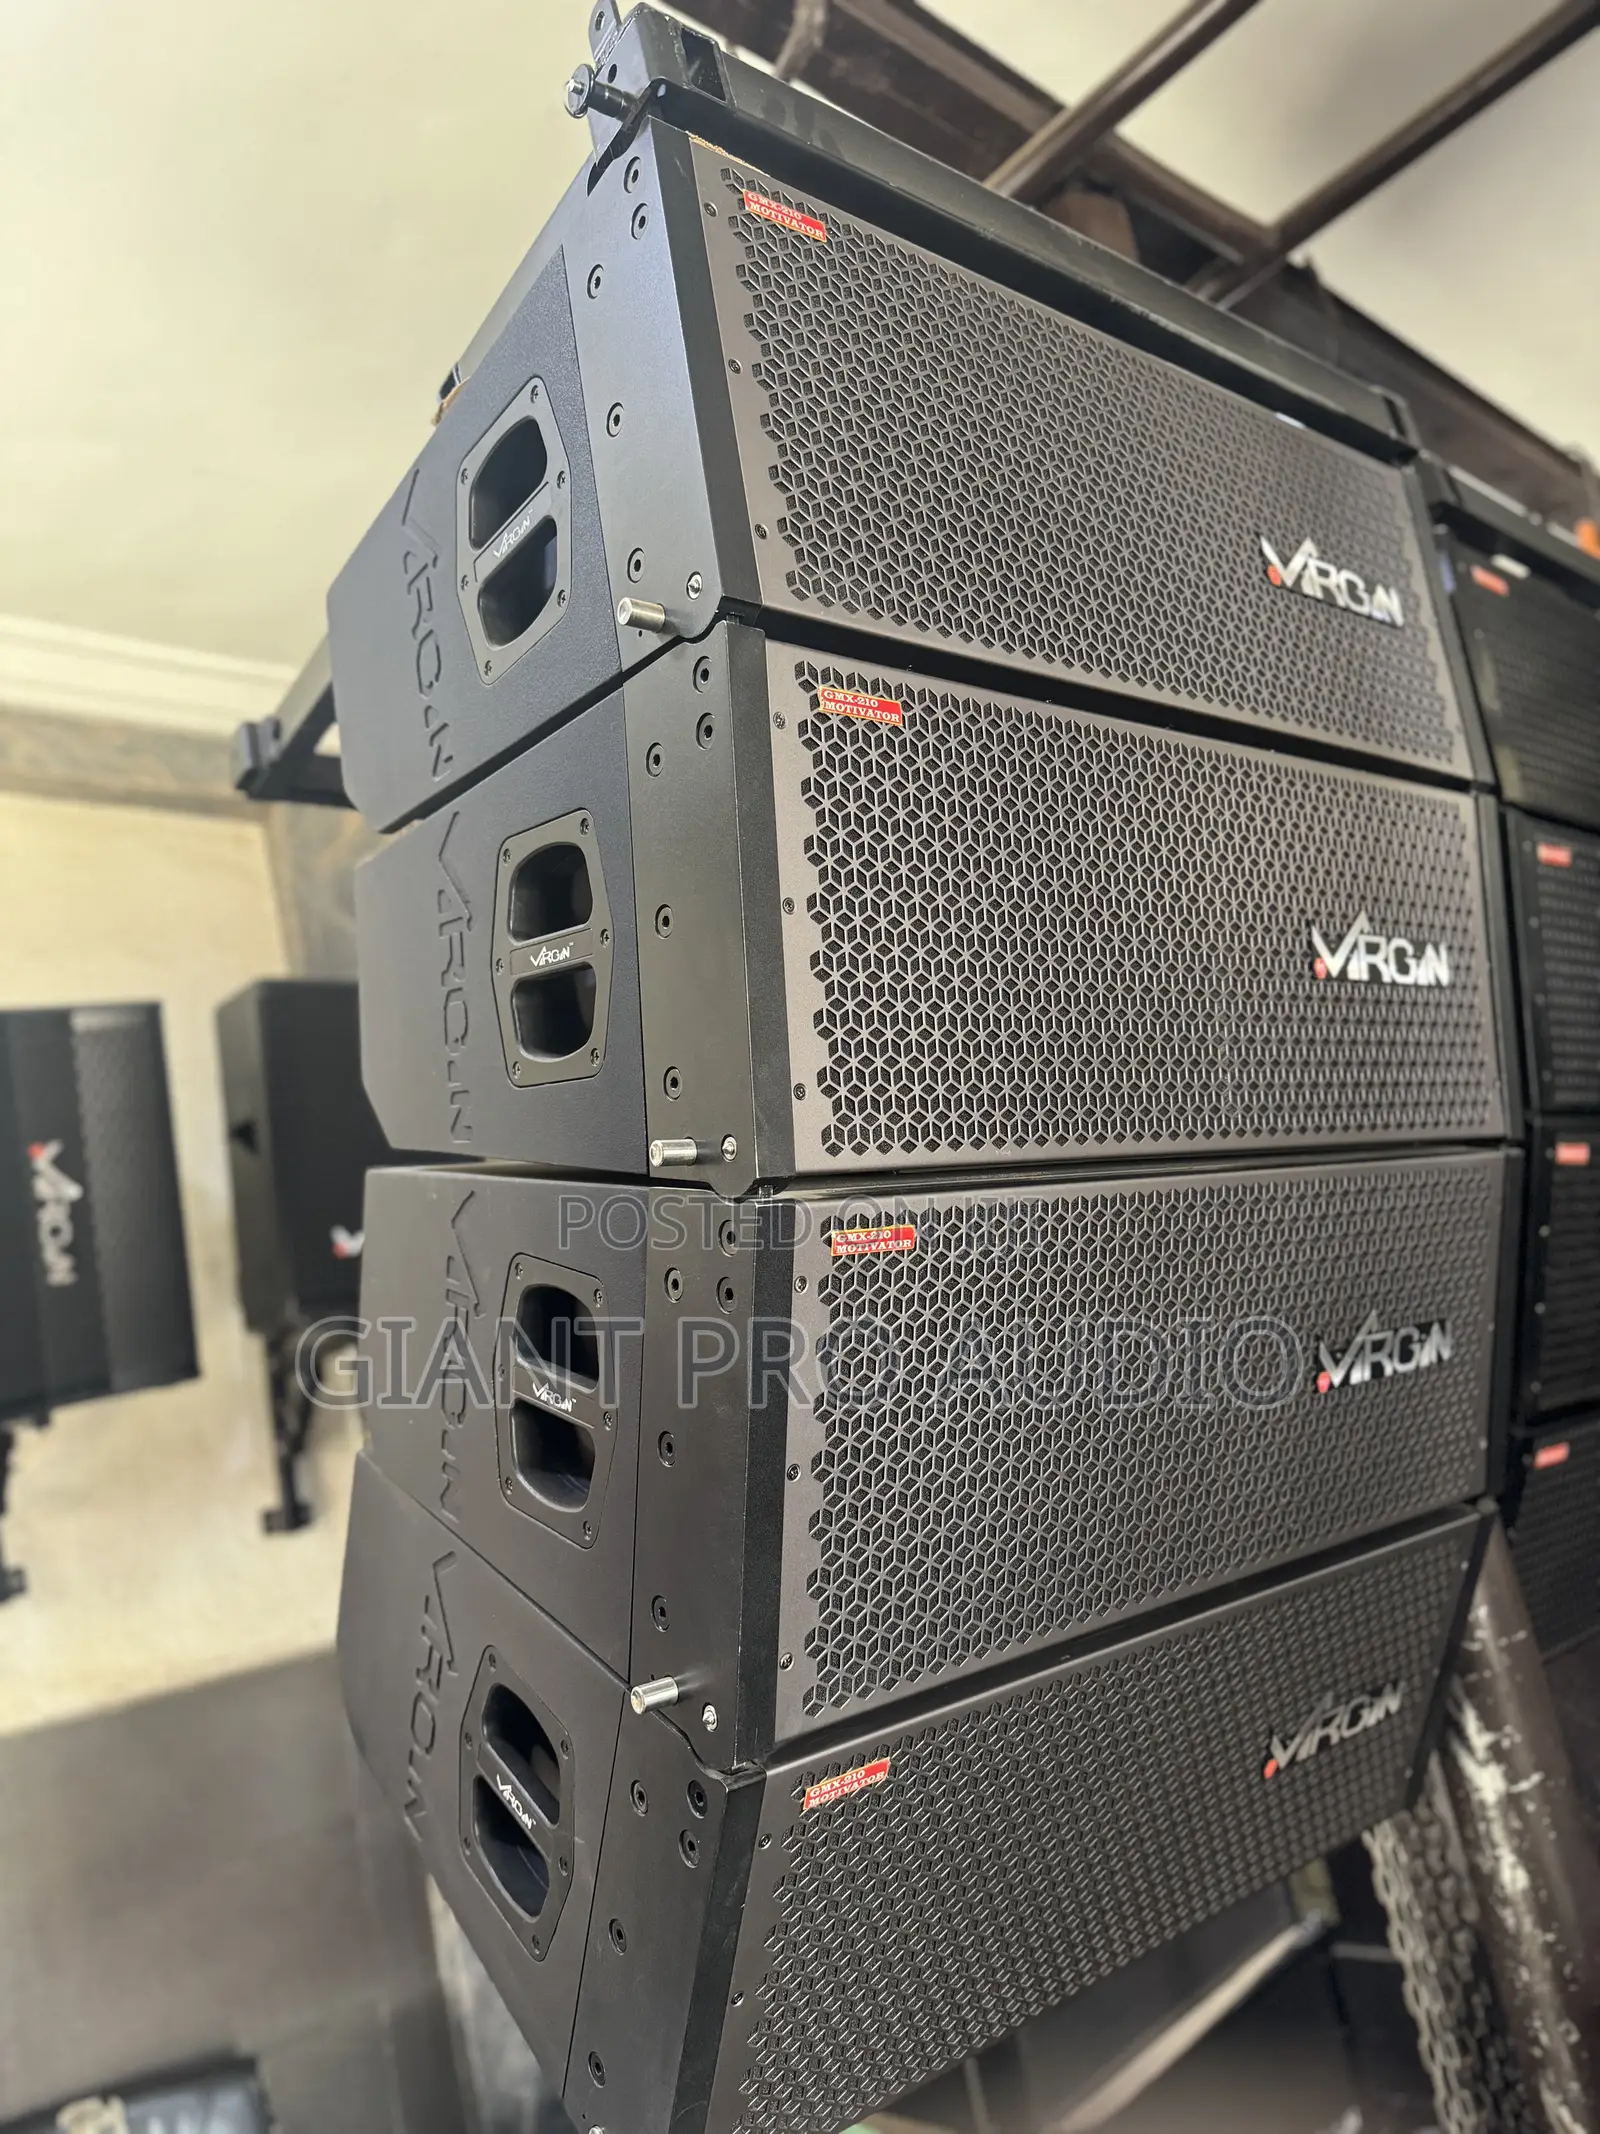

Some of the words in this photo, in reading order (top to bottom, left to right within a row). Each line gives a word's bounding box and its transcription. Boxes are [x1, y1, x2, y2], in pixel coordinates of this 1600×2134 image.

[749, 202, 825, 239] MOTIVATOR
[823, 690, 879, 708] GMX-210
[822, 701, 900, 723] MOTIVATOR
[835, 1239, 912, 1254] MOTIVATOR
[836, 1229, 892, 1243] GMX-210
[808, 1771, 886, 1807] MOTIVATOR
[809, 1769, 866, 1798] GMX-210
